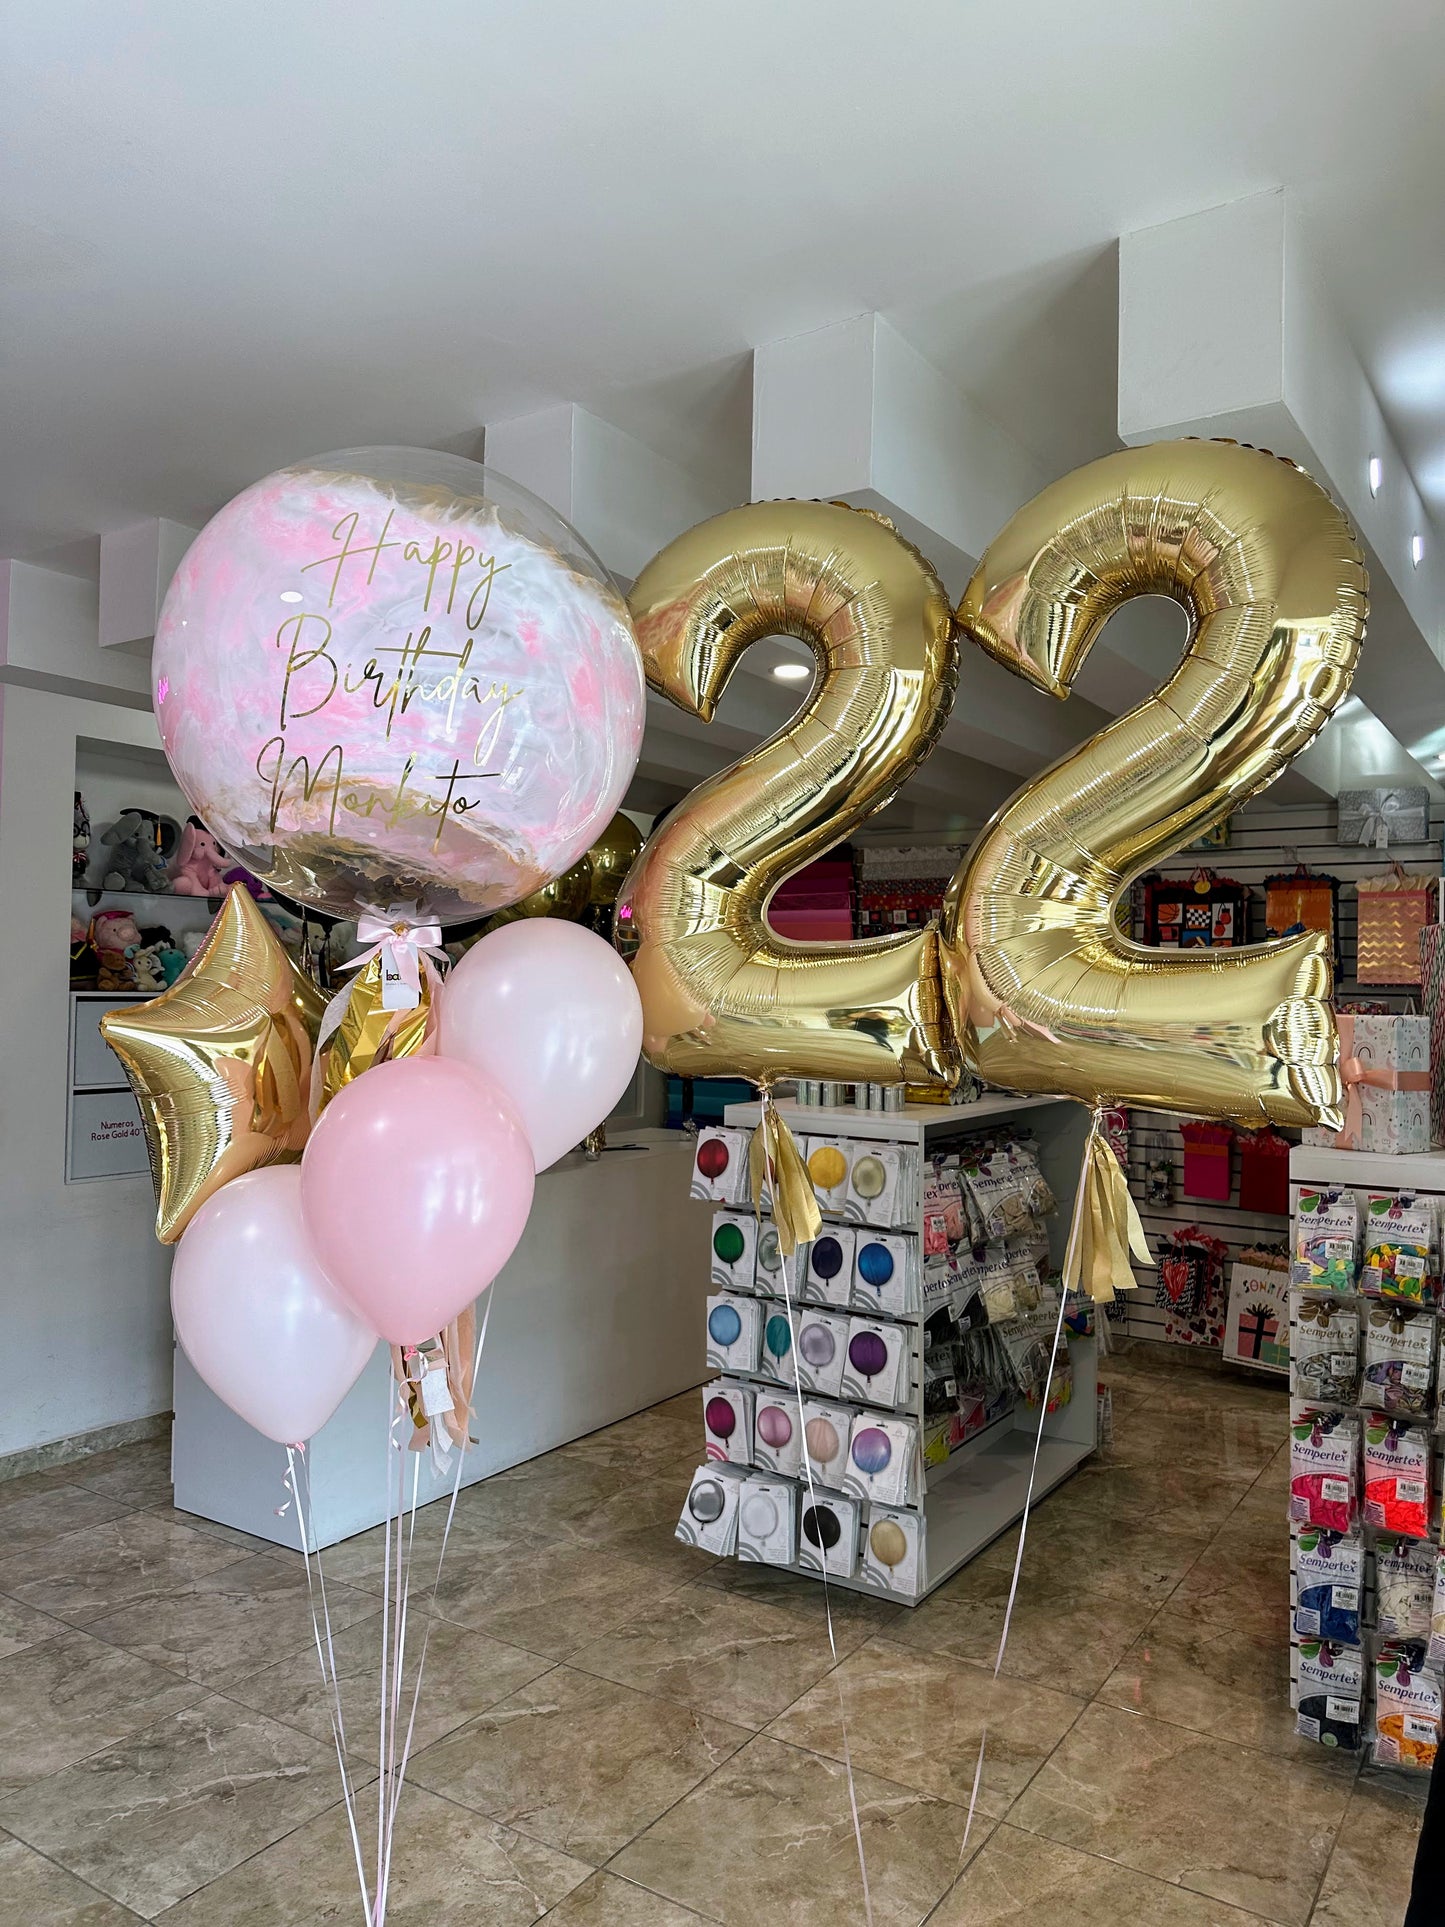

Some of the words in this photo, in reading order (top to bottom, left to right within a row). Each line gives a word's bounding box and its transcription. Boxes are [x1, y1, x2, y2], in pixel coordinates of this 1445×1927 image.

[301, 508, 513, 631] Happy
[276, 612, 525, 768] Birthday
[256, 735, 505, 854] Monkito
[91, 1132, 110, 1142] Rose
[111, 1129, 129, 1139] Gold
[100, 1120, 134, 1131] Numeros
[1368, 1217, 1426, 1235] Sempertex
[1299, 1325, 1356, 1339] Sempertex
[1369, 1329, 1427, 1350] Sempertex
[1292, 1443, 1347, 1462] Sempertex
[1366, 1447, 1422, 1467] Sempertex
[1298, 1554, 1358, 1573] Sempertex
[1300, 1661, 1358, 1685] Sempertex
[1377, 1679, 1437, 1704] Sempertex
